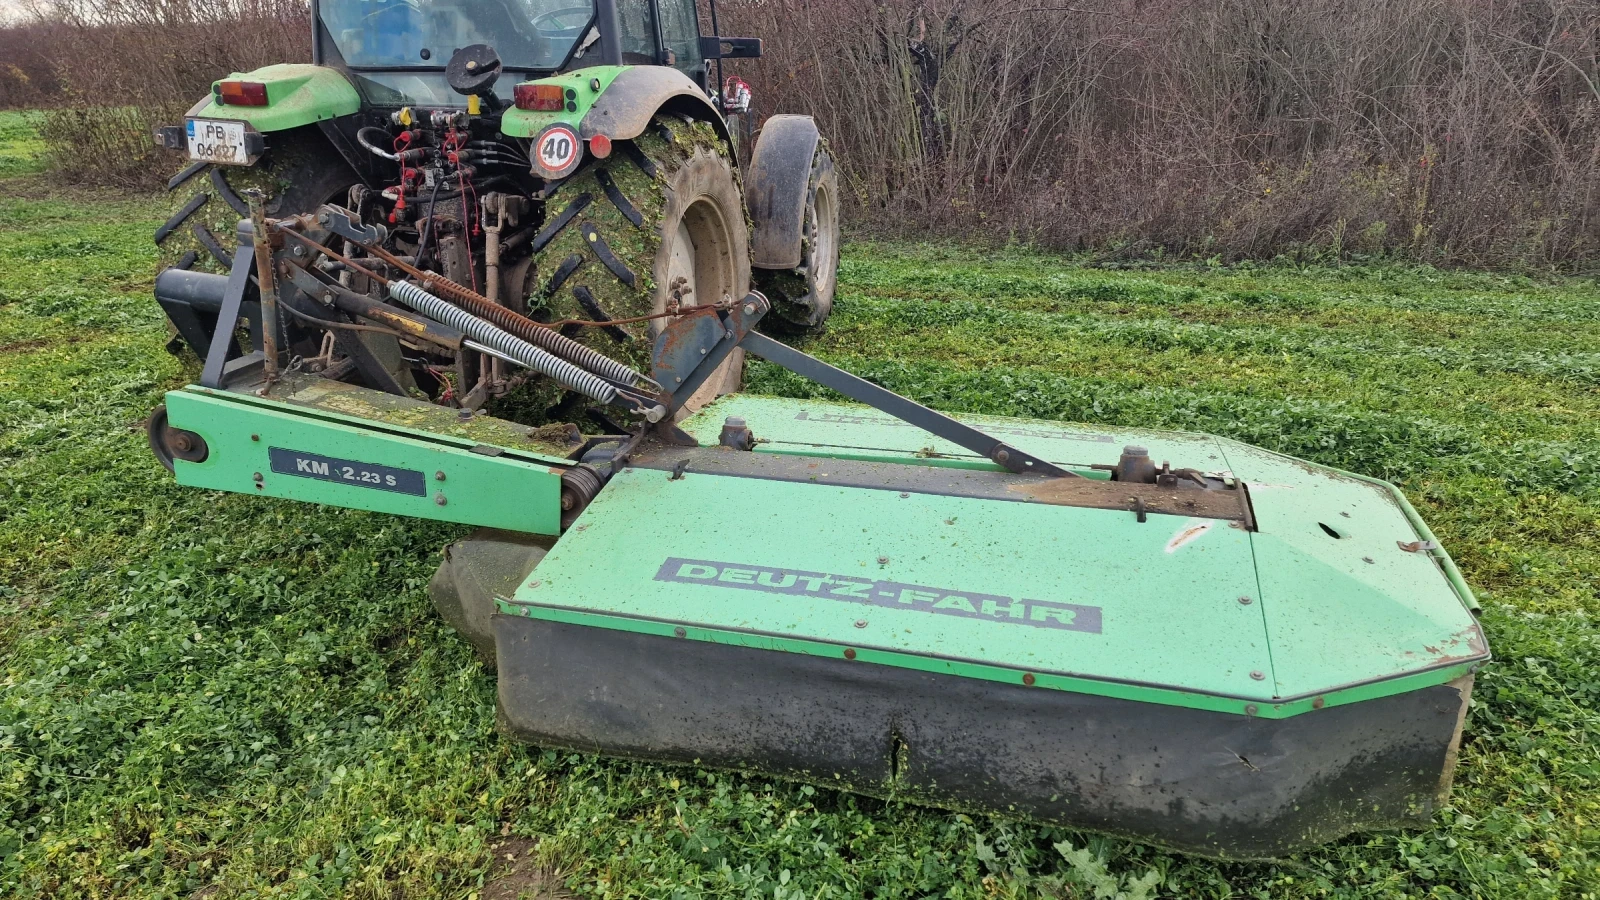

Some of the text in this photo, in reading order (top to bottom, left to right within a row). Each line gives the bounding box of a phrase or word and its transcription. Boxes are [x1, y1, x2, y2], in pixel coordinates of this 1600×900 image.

[206, 125, 225, 139] PB
[542, 138, 570, 160] 40
[296, 458, 397, 487] KM 2.23 S
[675, 563, 1078, 625] DEUTZ-FAHR
